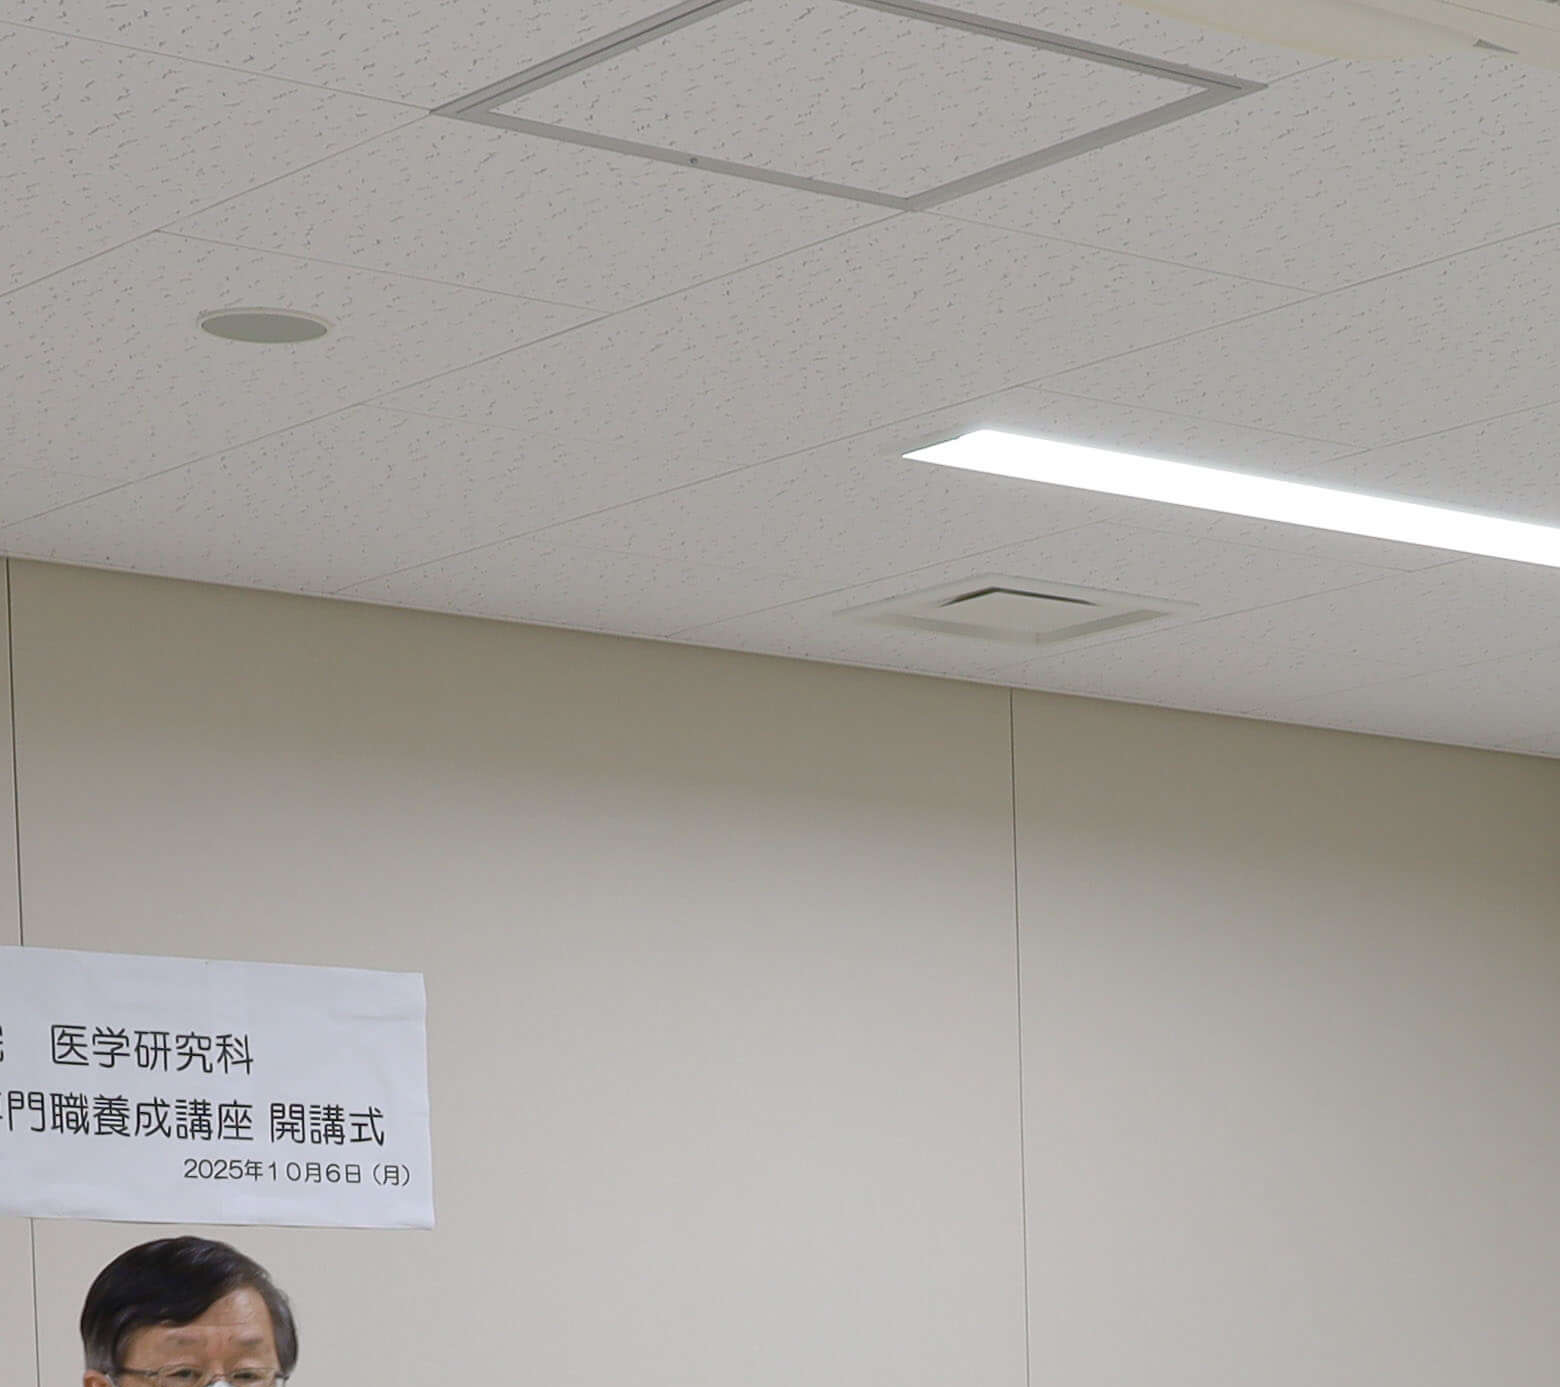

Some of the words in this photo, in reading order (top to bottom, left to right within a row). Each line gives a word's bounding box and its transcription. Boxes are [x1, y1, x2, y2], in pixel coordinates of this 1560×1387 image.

[51, 1024, 254, 1075] 医学研究科
[270, 1103, 385, 1147] 開講式
